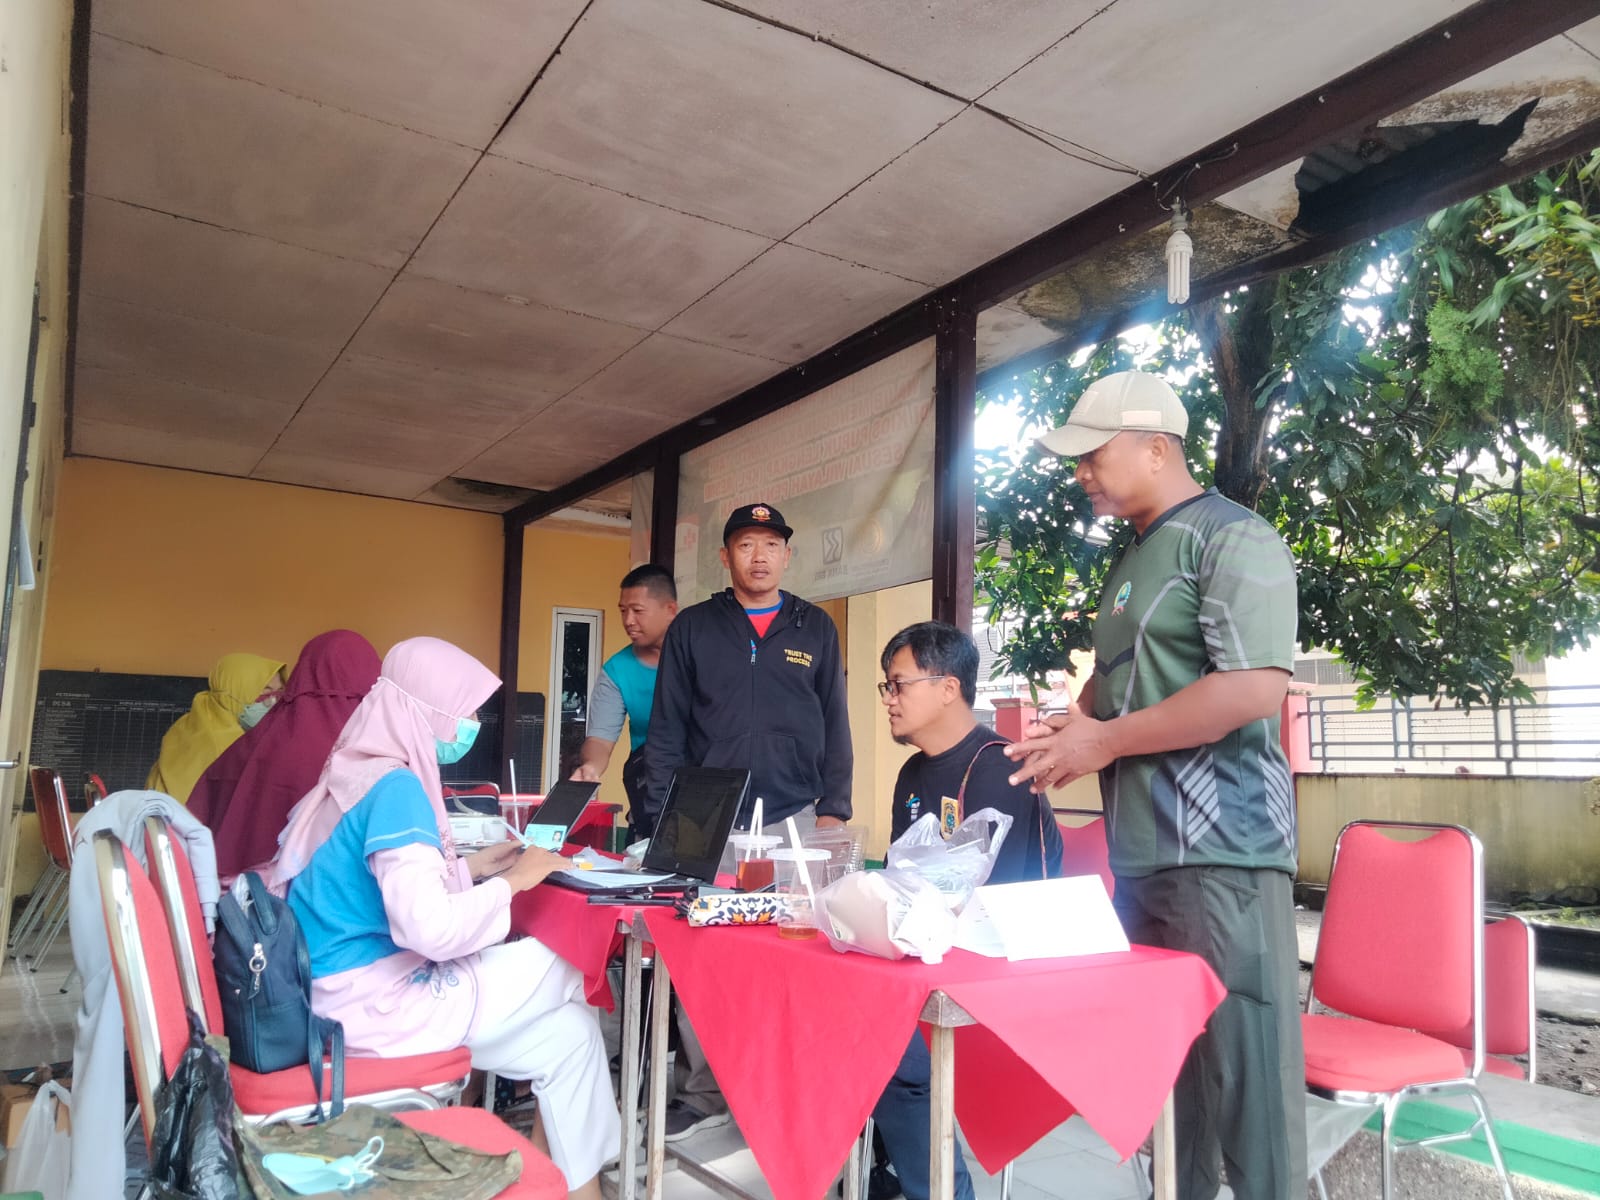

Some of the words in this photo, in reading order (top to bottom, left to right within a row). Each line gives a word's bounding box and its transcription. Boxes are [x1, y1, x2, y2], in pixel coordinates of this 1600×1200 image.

[784, 648, 802, 658] TRUST
[802, 652, 813, 662] THE
[786, 656, 811, 668] PROCESS
